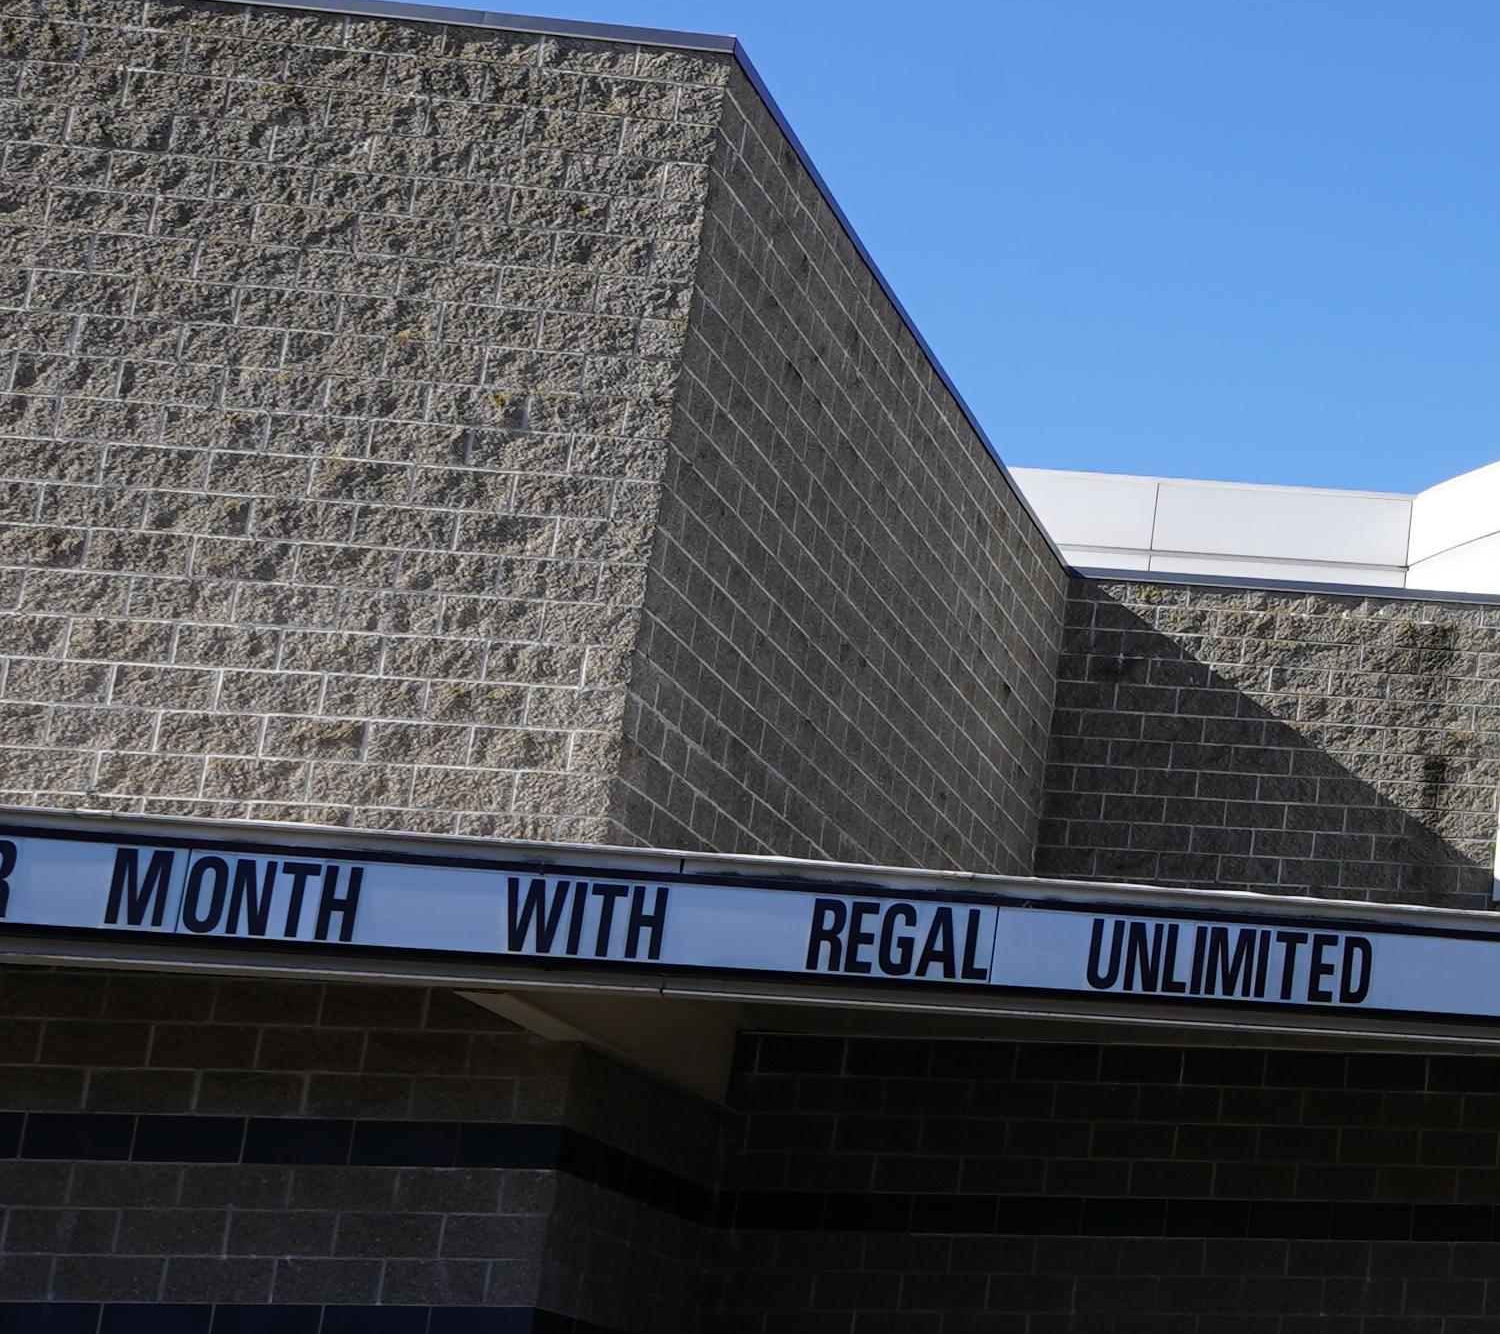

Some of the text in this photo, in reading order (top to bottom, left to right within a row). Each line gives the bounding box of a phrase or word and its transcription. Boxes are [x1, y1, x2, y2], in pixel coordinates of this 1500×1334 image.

[104, 848, 364, 942] MONTH
[508, 877, 669, 960] WITH
[806, 898, 988, 981] REGAL
[1087, 918, 1372, 1003] UNLIMITED
